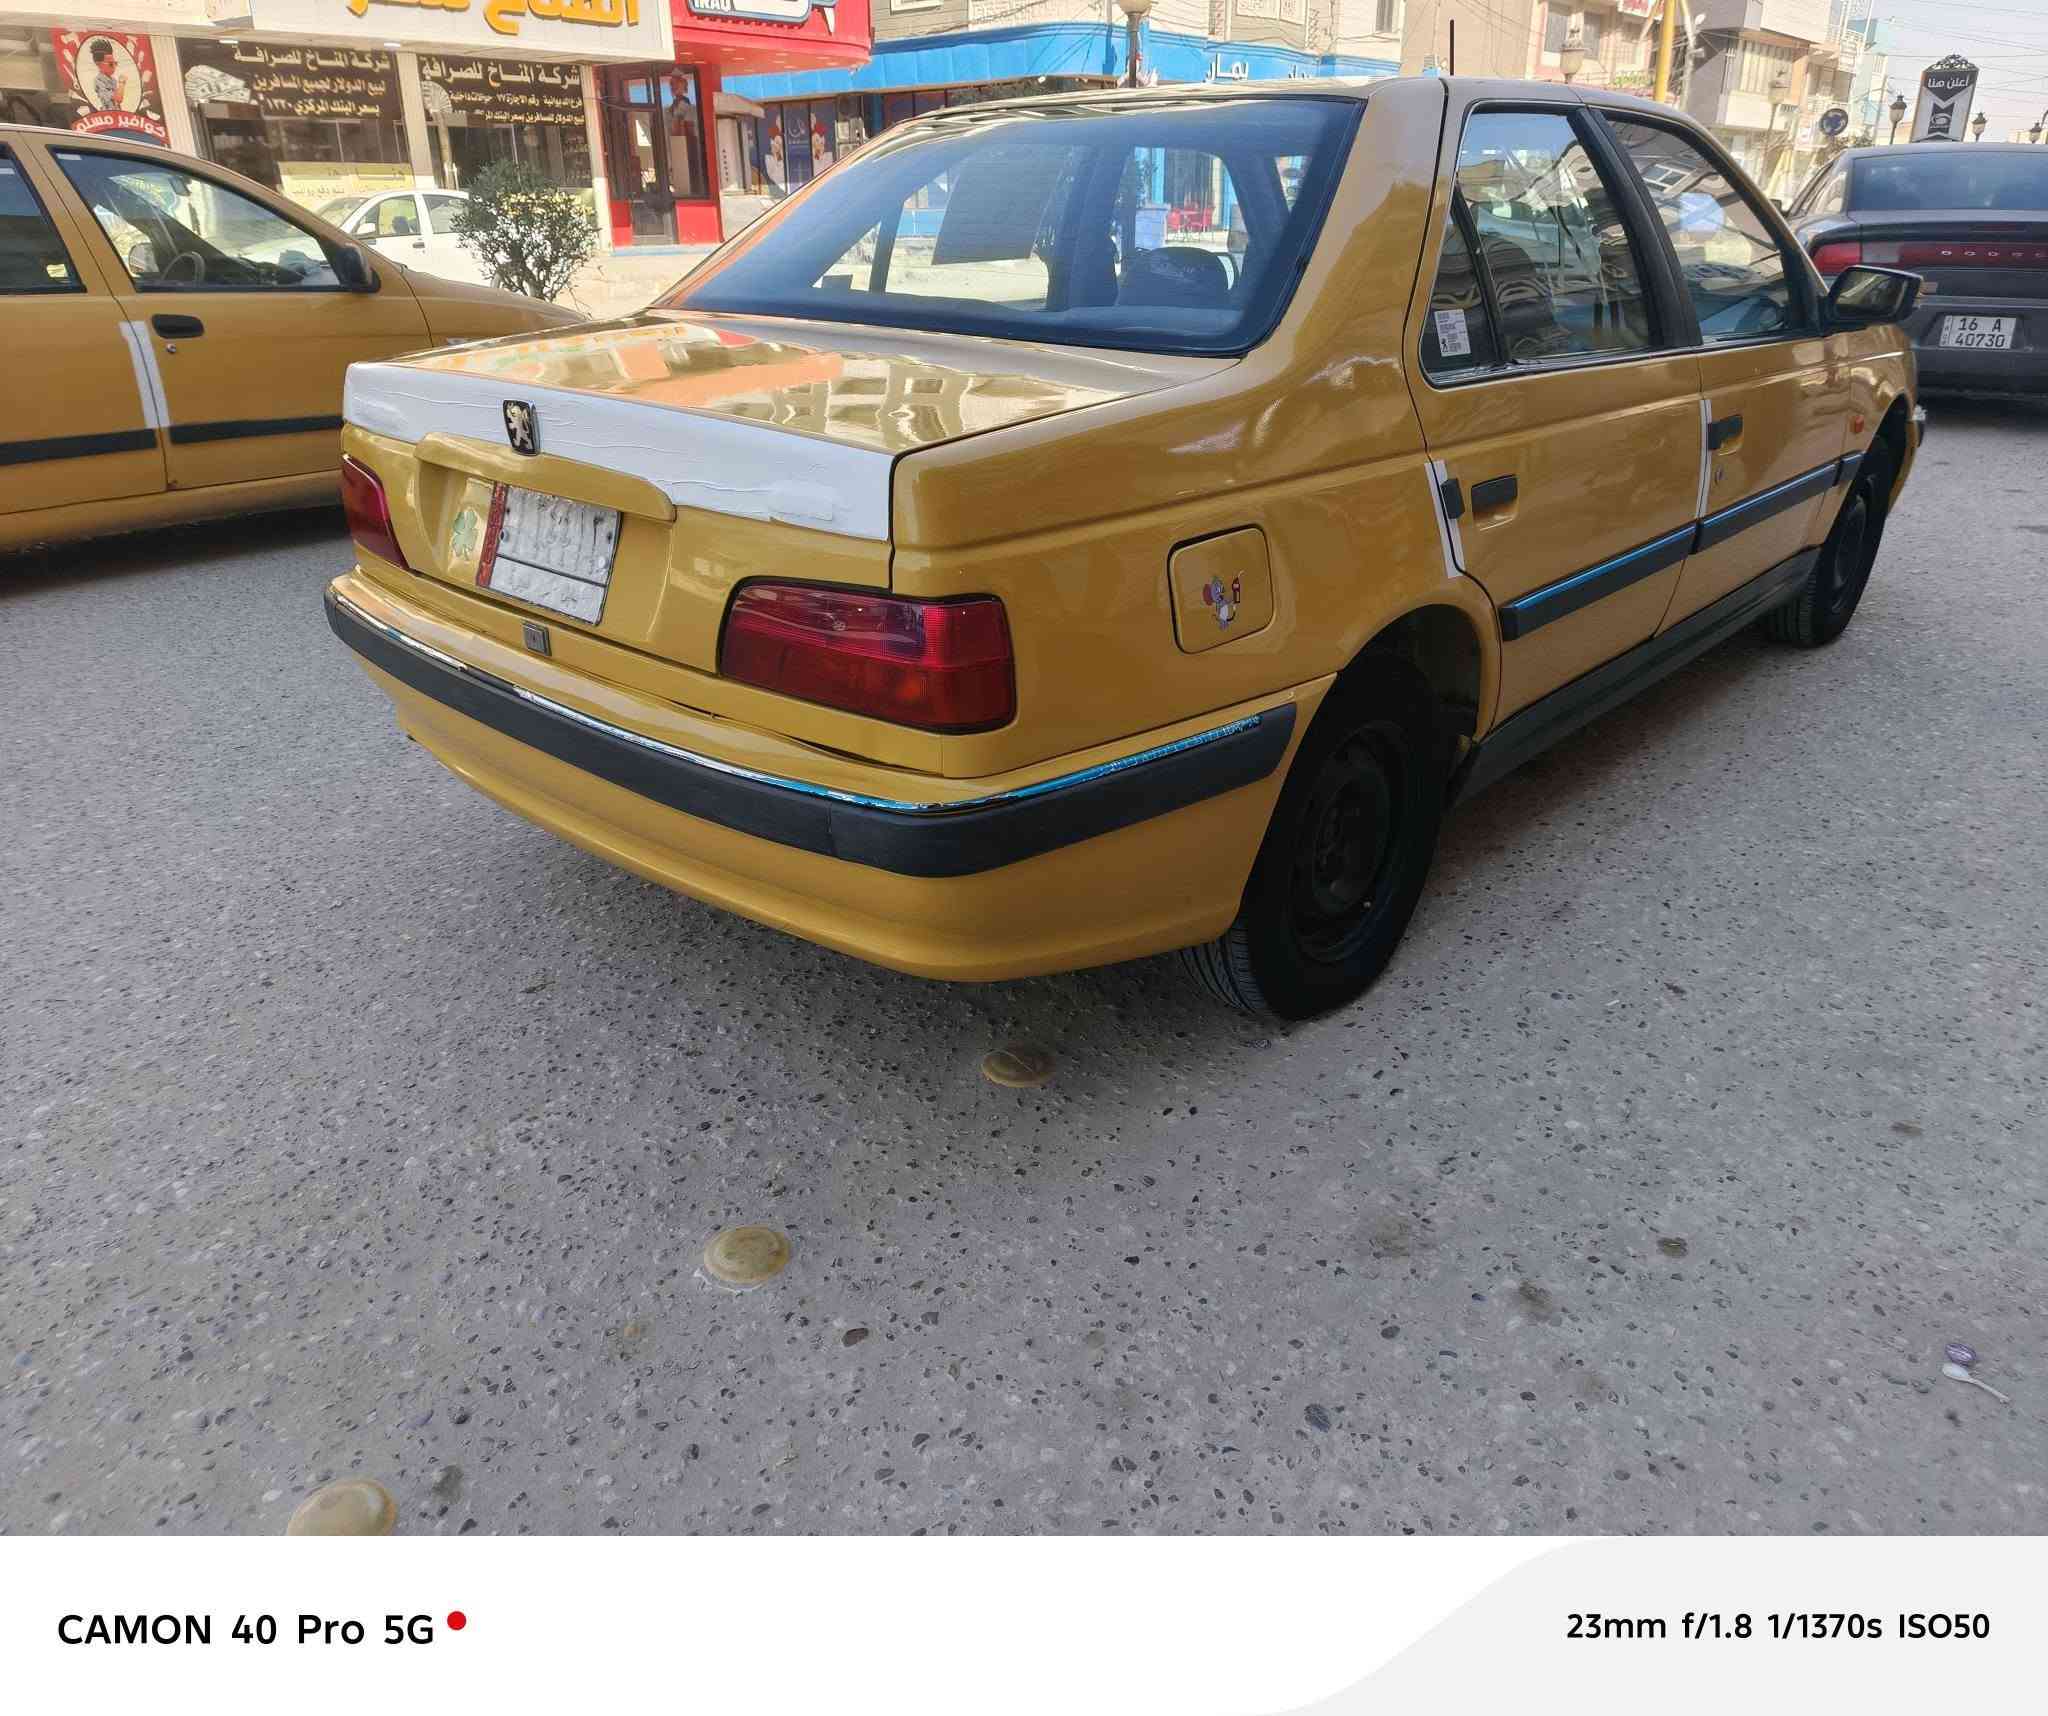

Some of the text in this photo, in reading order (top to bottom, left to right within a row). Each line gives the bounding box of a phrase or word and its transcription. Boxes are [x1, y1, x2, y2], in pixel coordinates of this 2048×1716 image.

[306, 49, 349, 70] المناخ
[350, 51, 391, 72] شركة
[487, 61, 534, 87] المناخ
[537, 64, 580, 89] شركة
[1958, 317, 1979, 332] 16
[1991, 318, 2002, 333] A
[1954, 332, 2006, 348] 40730
